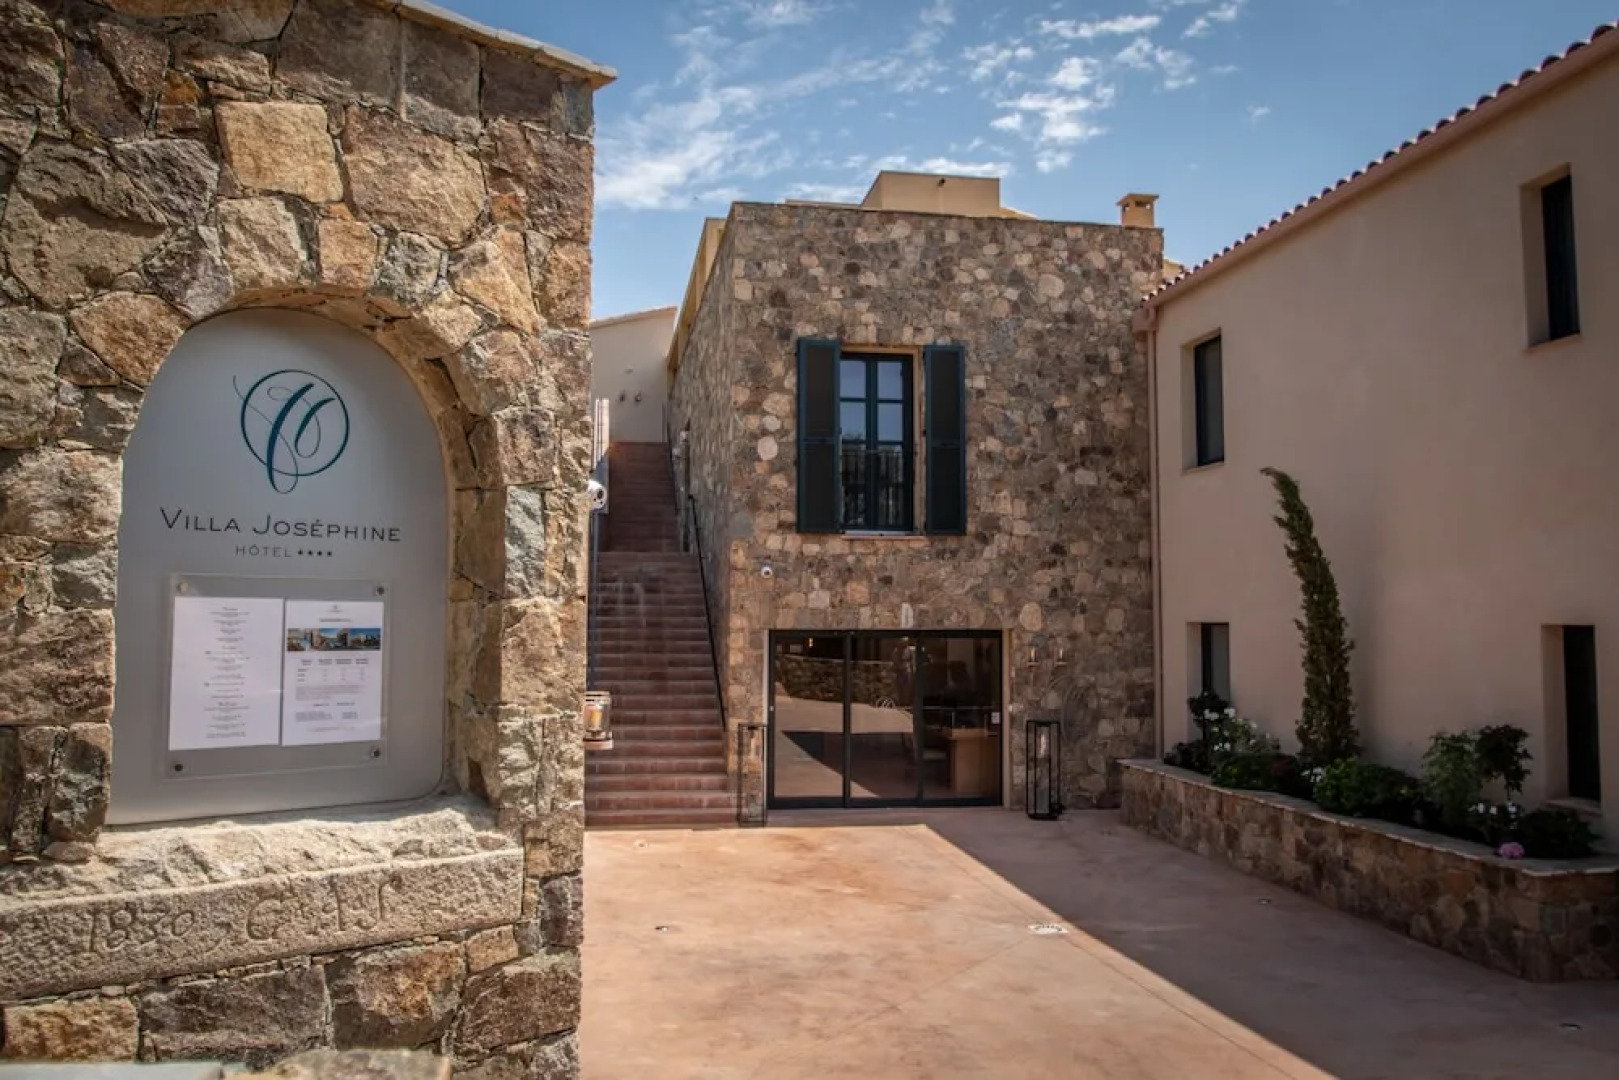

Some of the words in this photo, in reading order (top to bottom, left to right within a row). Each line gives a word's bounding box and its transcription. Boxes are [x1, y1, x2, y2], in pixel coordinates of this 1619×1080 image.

[159, 506, 241, 533] VILLA
[251, 514, 402, 542] JOSÉPHINE
[235, 544, 293, 558] HÔTEL
